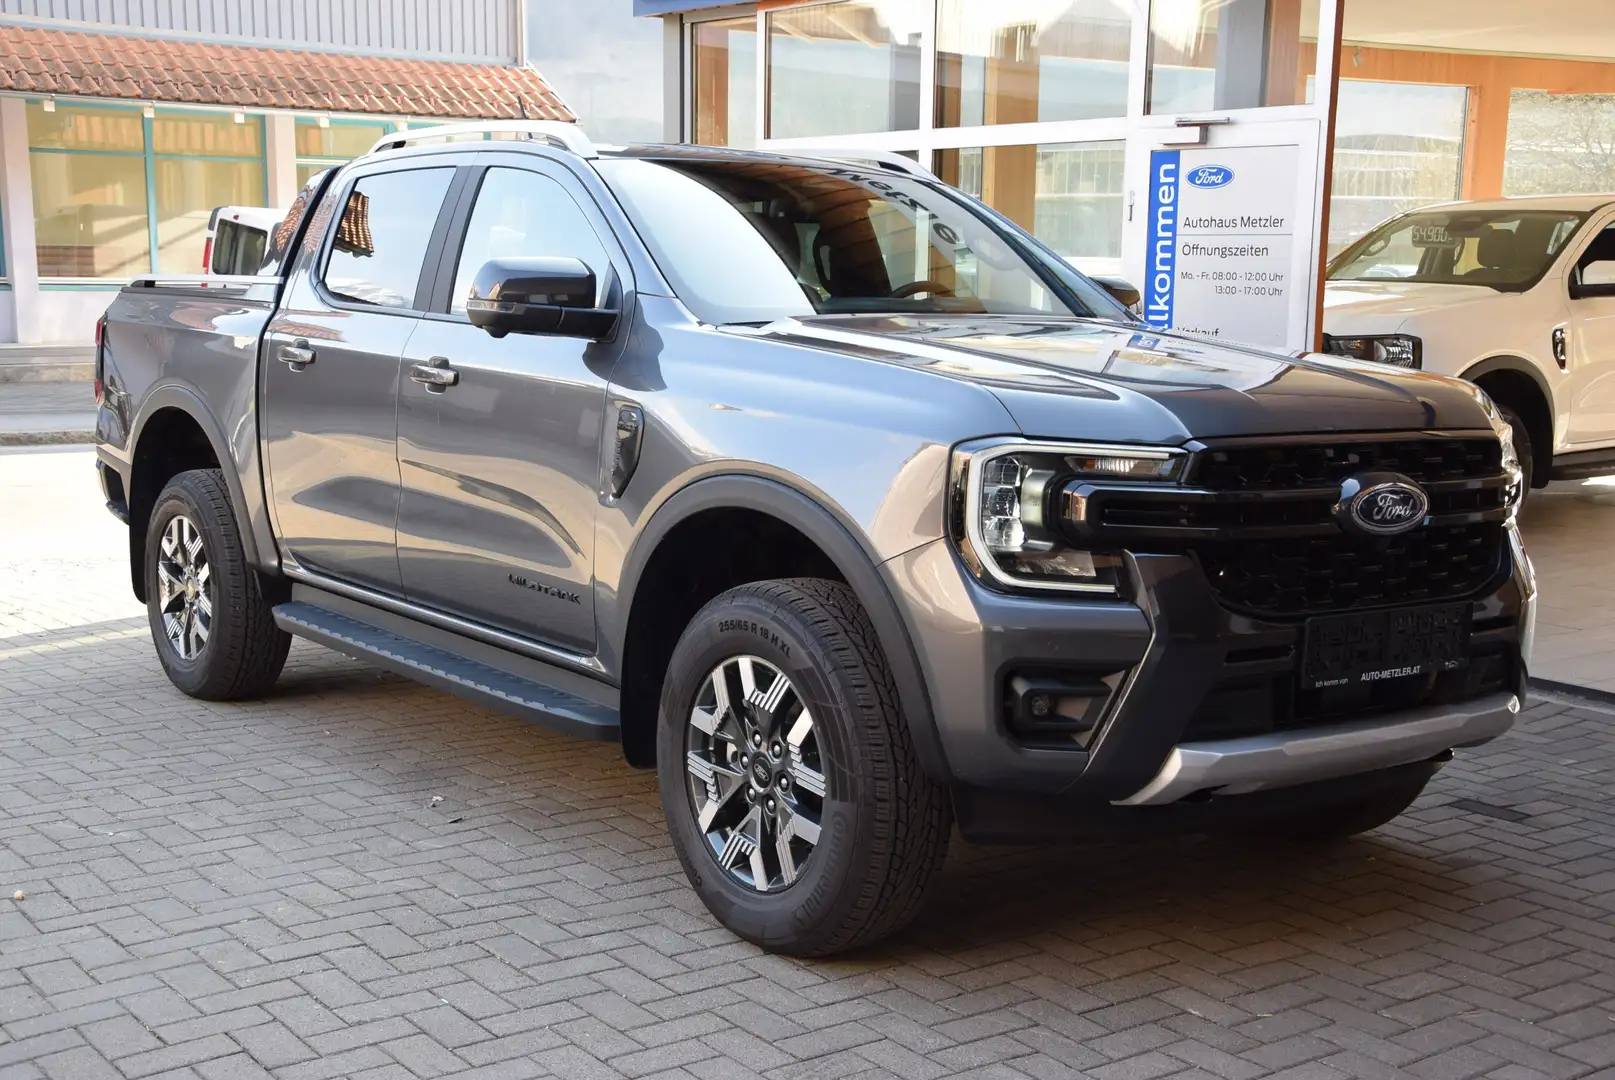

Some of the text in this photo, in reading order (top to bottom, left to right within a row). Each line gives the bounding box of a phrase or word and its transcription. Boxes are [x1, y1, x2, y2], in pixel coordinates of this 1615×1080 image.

[1183, 215, 1285, 228] Autohaus Metzler
[1148, 163, 1176, 329] lkommen
[1182, 242, 1269, 259] Öffnungszeiten
[1180, 271, 1195, 280] Mo.
[1201, 271, 1211, 280] Fr.
[1212, 271, 1238, 281] 08:00
[1244, 272, 1267, 282] 12:00
[1268, 272, 1284, 282] Uhr
[1215, 285, 1237, 295] 13:00
[1244, 286, 1266, 296] 17:00
[1267, 287, 1283, 297] Uhr
[1373, 493, 1414, 520] Ford
[718, 619, 791, 659] 255/65 R 18 H XL
[1315, 680, 1323, 688] Ich
[1324, 679, 1339, 687] komm
[1360, 665, 1421, 682] AUTO-METZLER.AT
